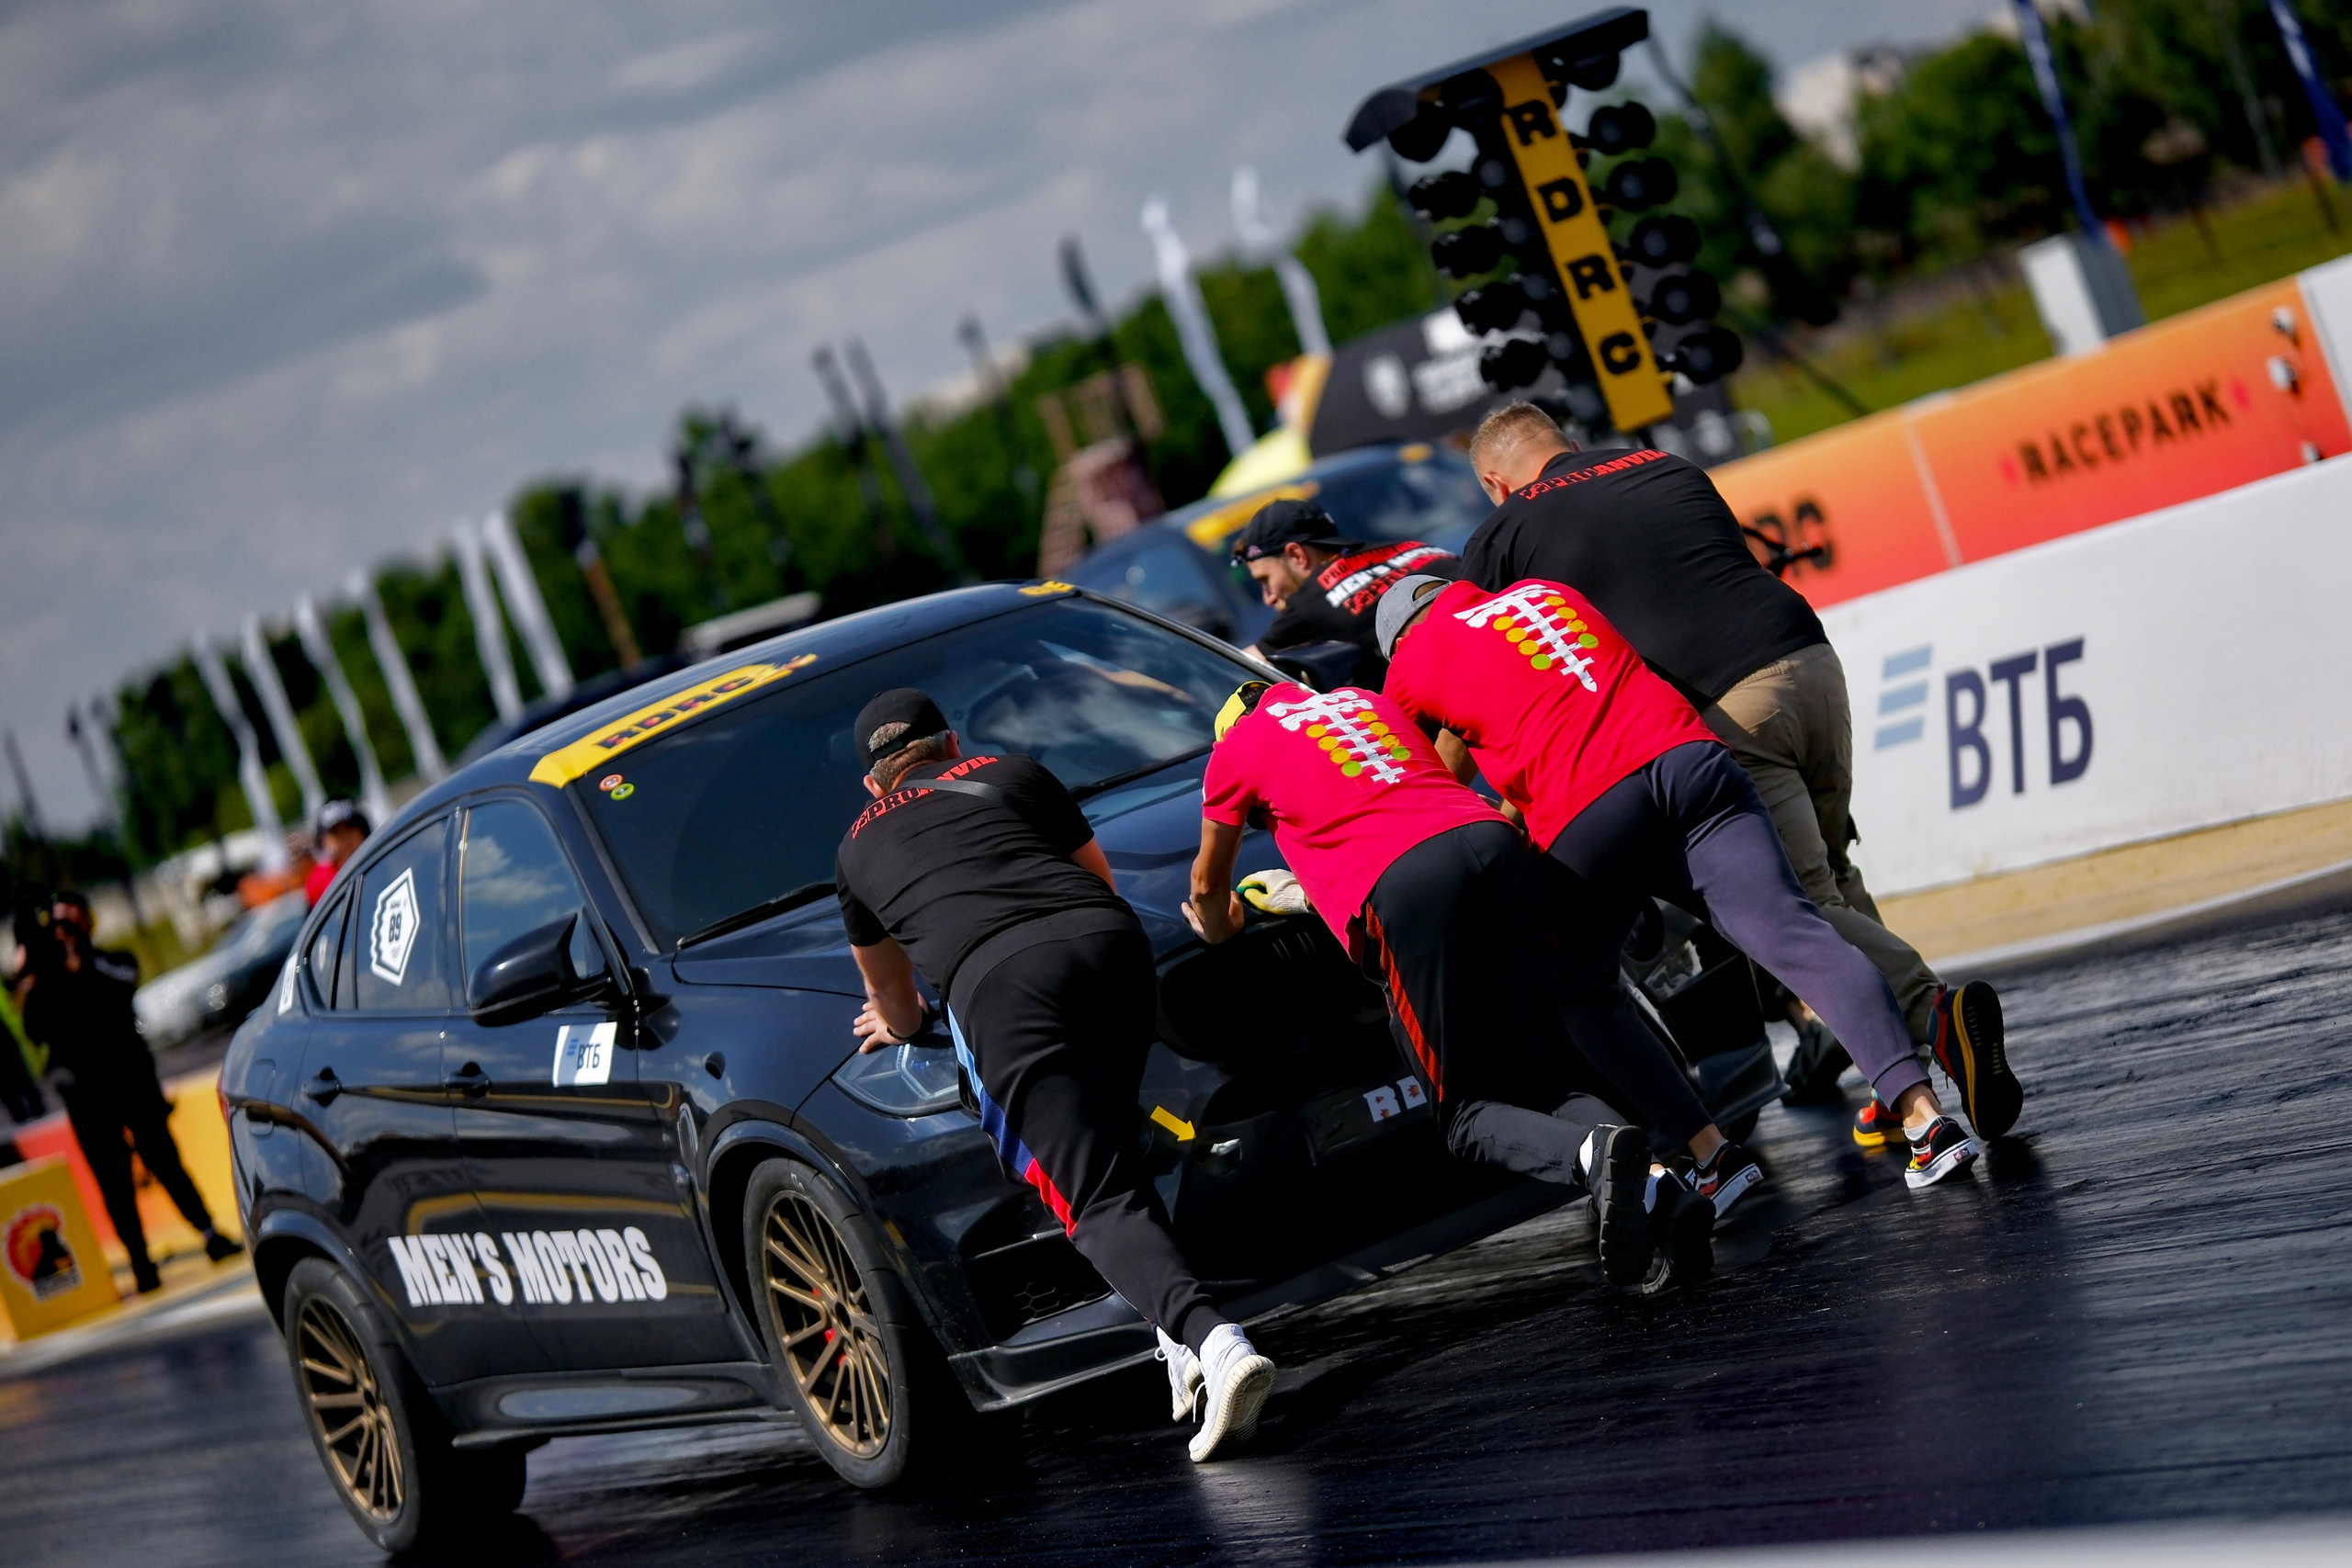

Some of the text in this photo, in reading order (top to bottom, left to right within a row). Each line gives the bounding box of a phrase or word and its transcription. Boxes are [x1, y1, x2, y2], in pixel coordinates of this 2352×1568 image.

[1508, 99, 1642, 376] RDRC
[2016, 379, 2230, 483] RACEPARK
[594, 678, 754, 750] RDRC
[1945, 636, 2094, 810] ВТБ
[389, 912, 402, 942] 89
[577, 1043, 602, 1070] ВТБ
[388, 1226, 667, 1307] MEN'S MOTORS
